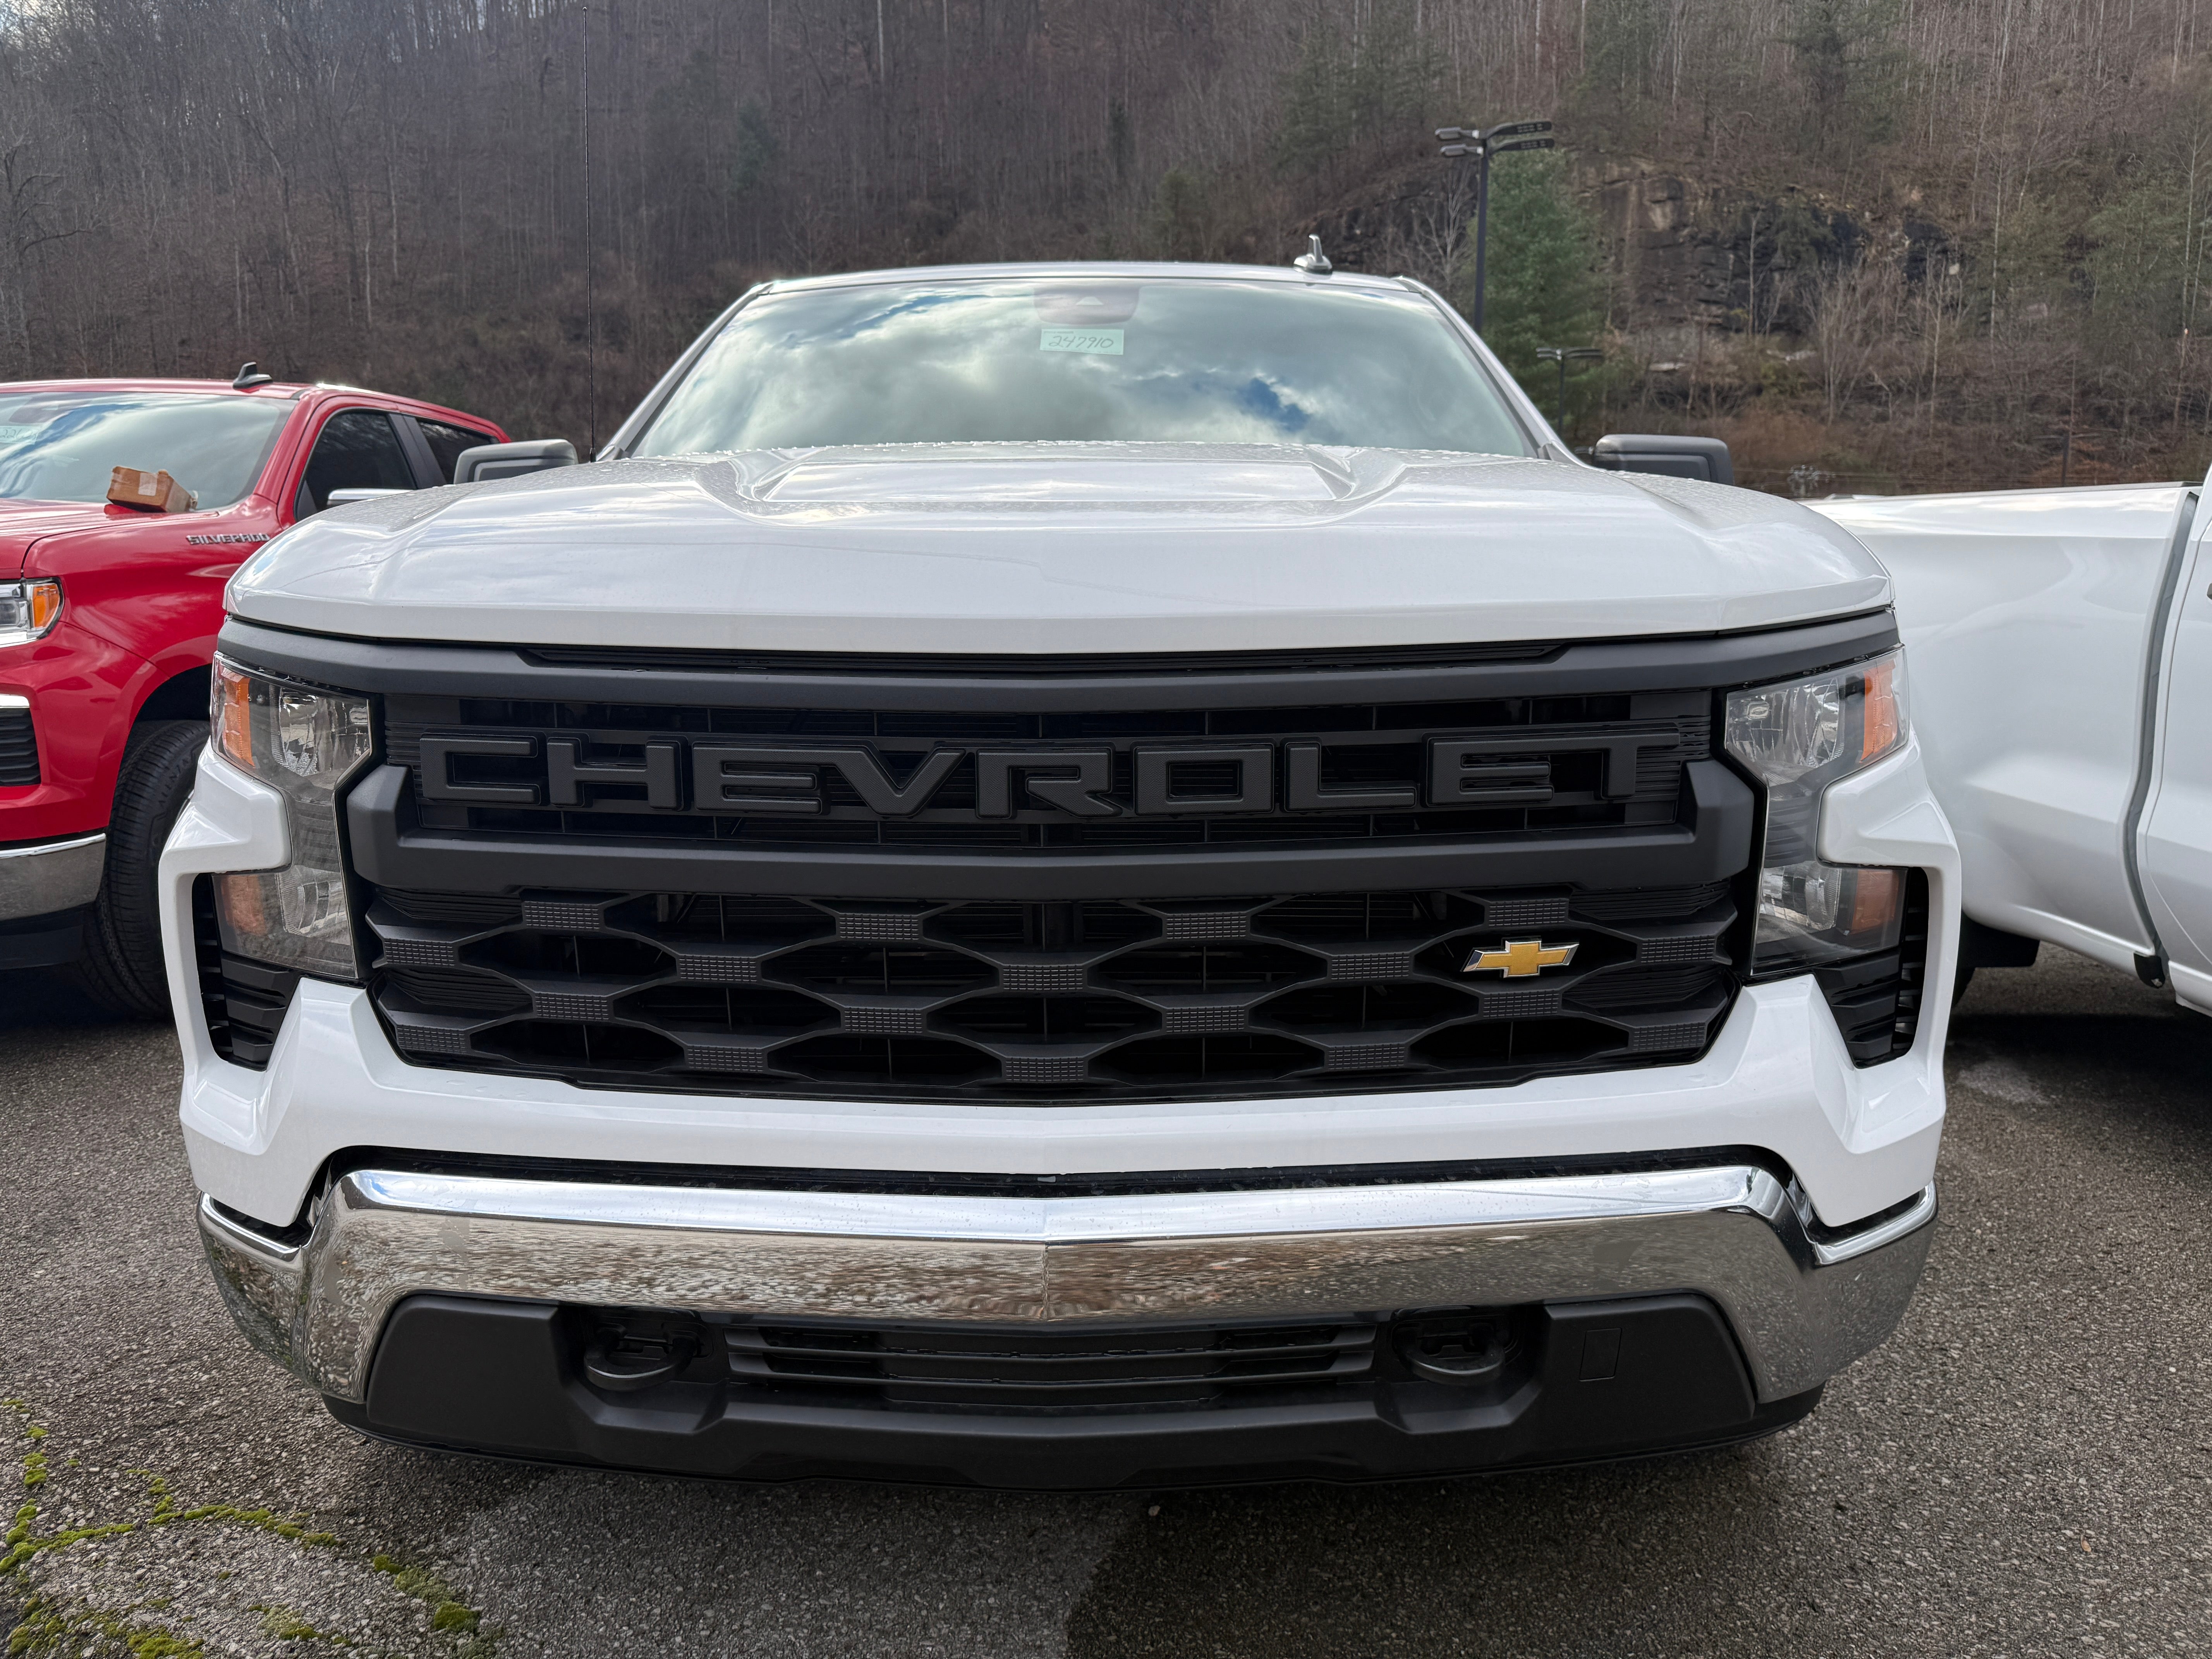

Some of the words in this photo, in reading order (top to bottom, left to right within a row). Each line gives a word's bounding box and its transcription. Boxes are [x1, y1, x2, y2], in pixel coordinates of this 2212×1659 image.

[1048, 335, 1114, 349] 247910
[186, 533, 270, 545] SILVERADO
[419, 725, 1681, 819] CHEVROLET
